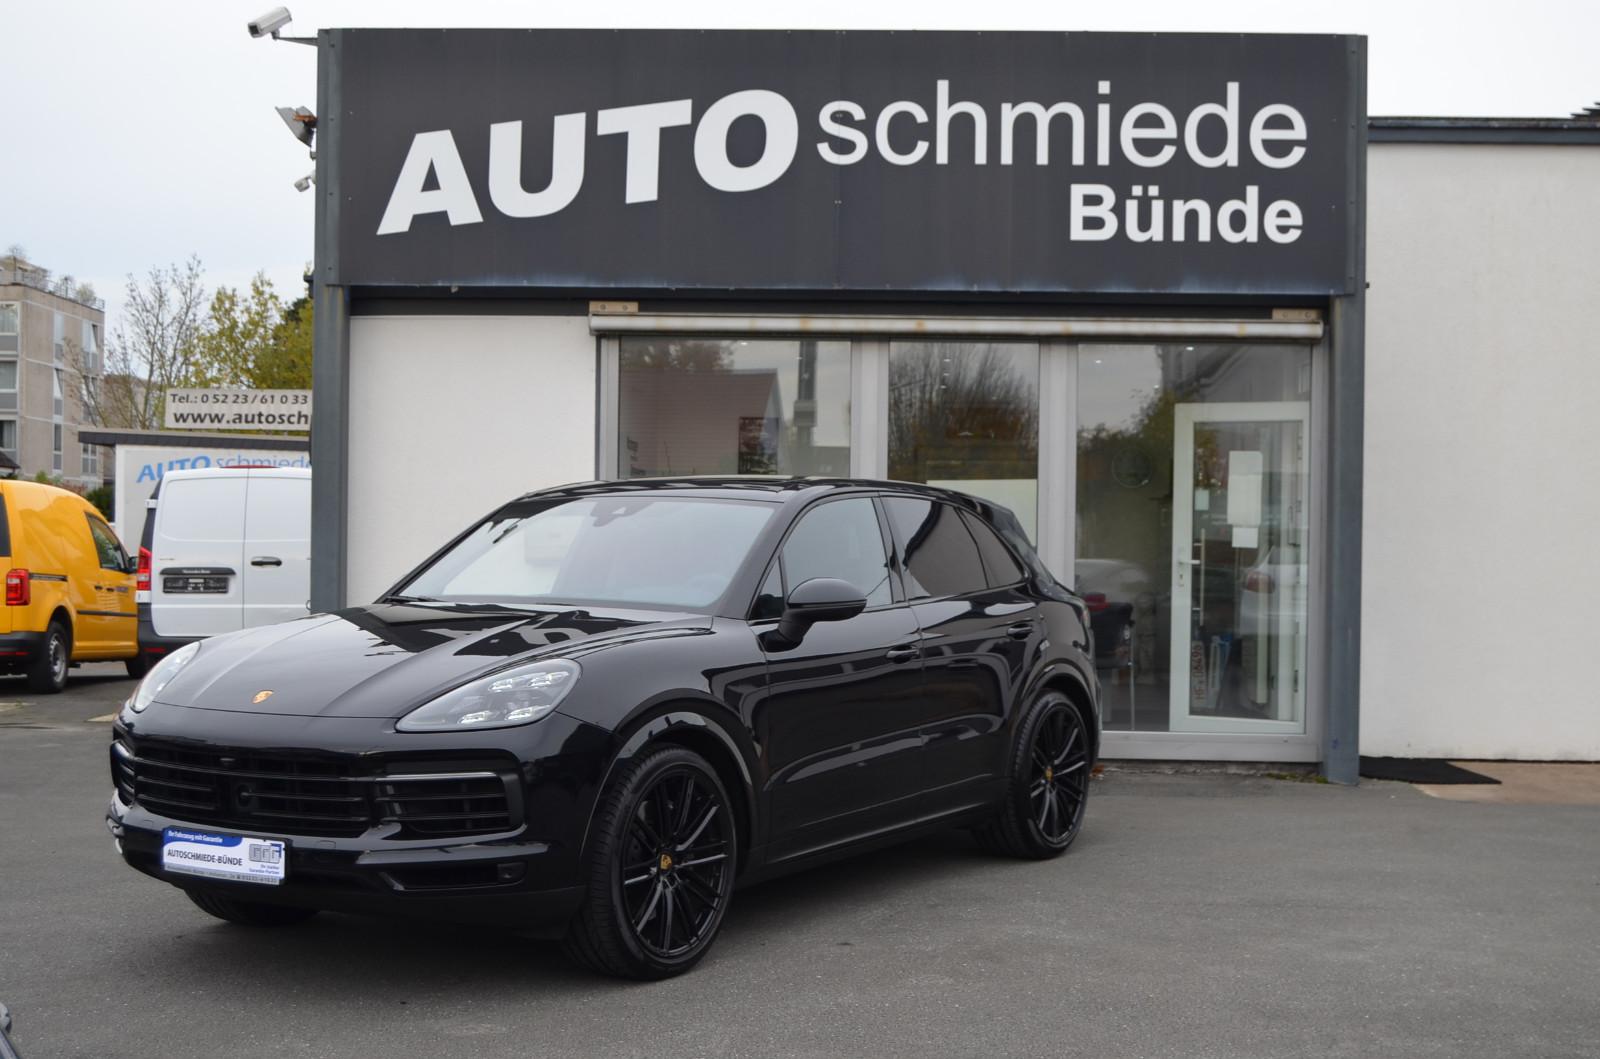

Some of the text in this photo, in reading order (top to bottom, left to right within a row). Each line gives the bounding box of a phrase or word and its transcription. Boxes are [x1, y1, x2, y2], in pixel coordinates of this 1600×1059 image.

[376, 79, 1307, 235] AUTO schmiede
[1069, 183, 1303, 244] Bünde
[170, 393, 198, 404] Tel.:
[201, 394, 209, 404] 0
[212, 394, 228, 404] 52
[233, 394, 249, 404] 23
[260, 395, 275, 405] 61
[280, 395, 288, 405] 0
[291, 395, 308, 405] 33
[174, 411, 309, 425] www.autosch
[136, 454, 312, 483] AUTO schmied
[167, 849, 243, 866] AUTOSCHMIEDE-BÜNDE
